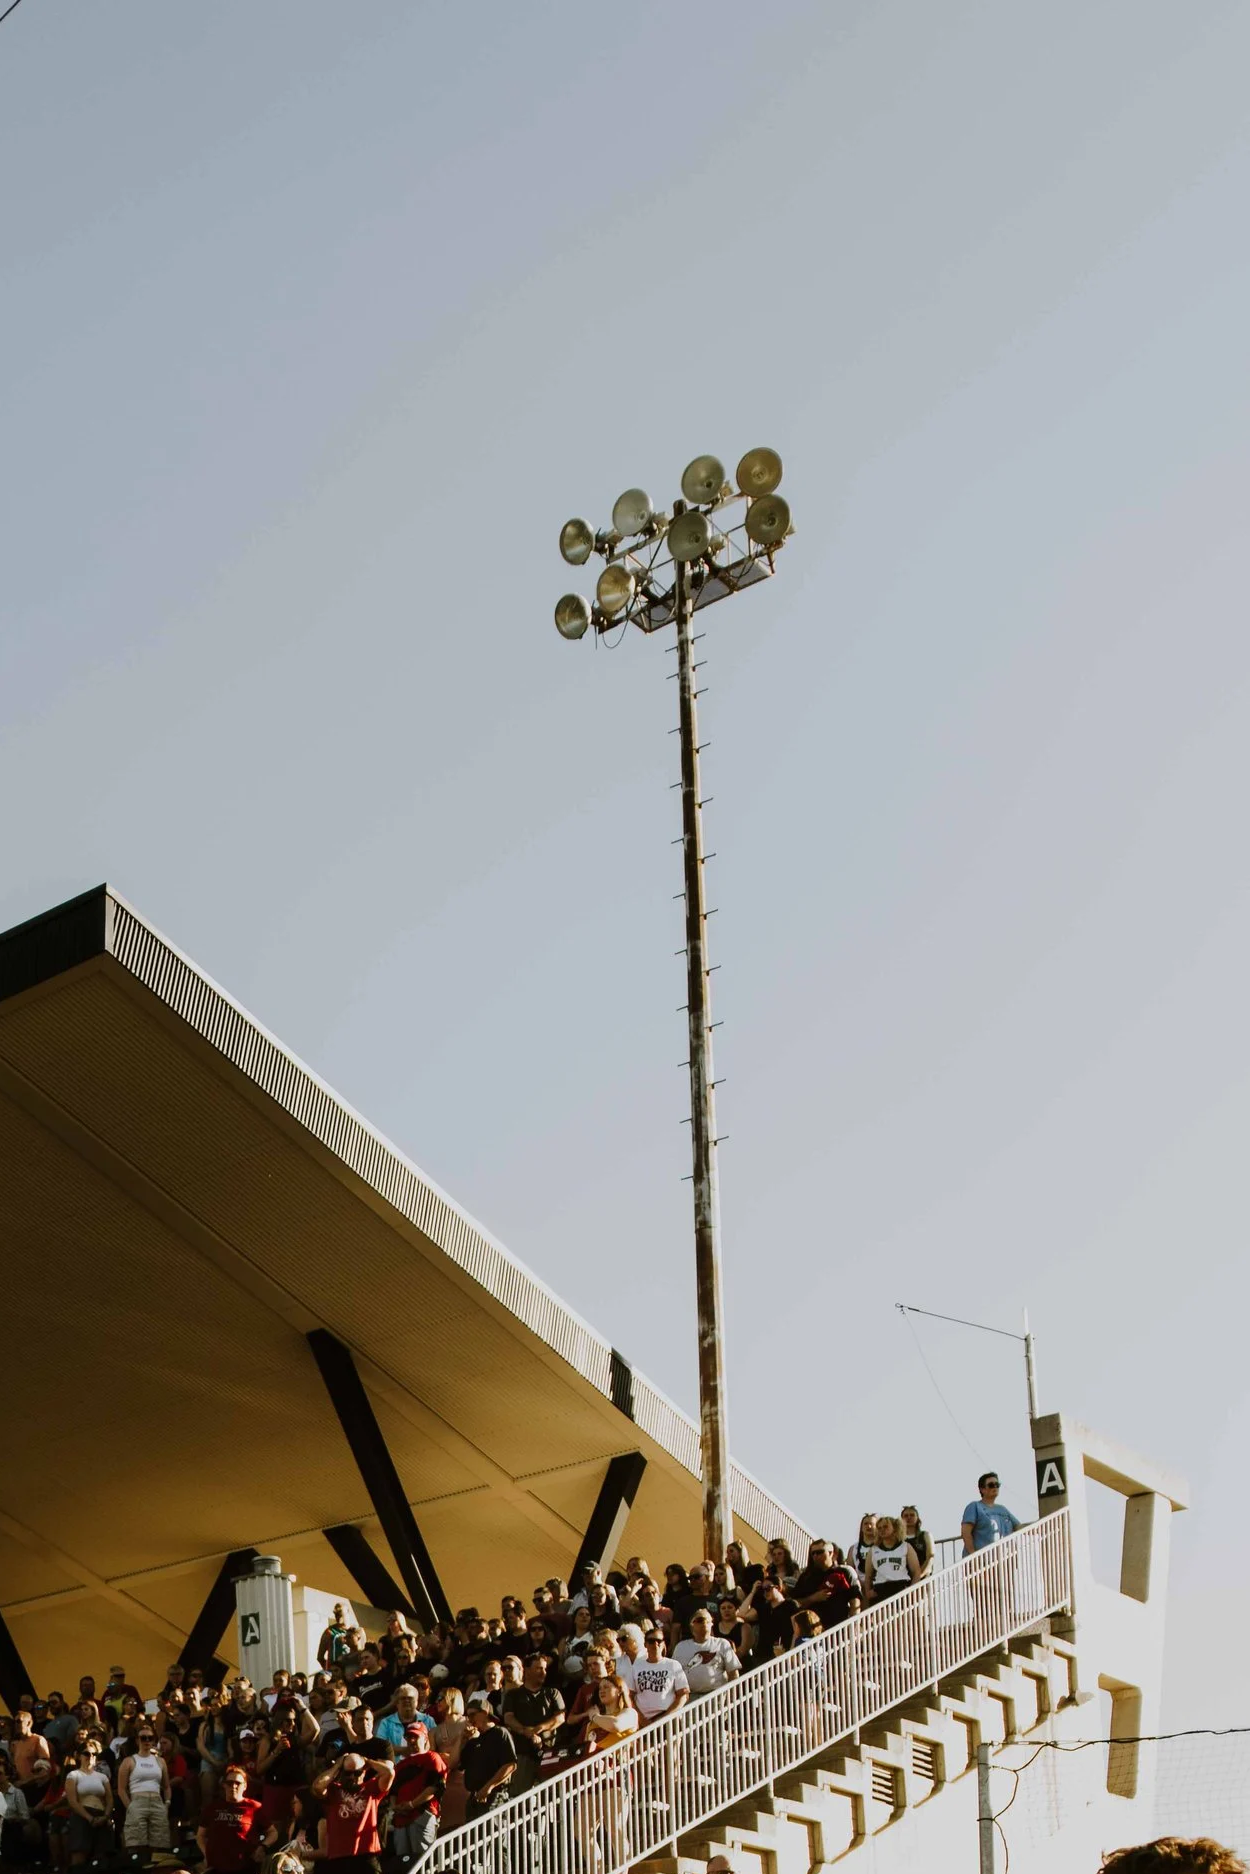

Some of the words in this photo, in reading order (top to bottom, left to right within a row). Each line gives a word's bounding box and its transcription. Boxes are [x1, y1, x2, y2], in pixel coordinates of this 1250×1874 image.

[1040, 1462, 1064, 1494] A
[244, 1616, 259, 1644] A
[637, 1670, 669, 1678] GOOD
